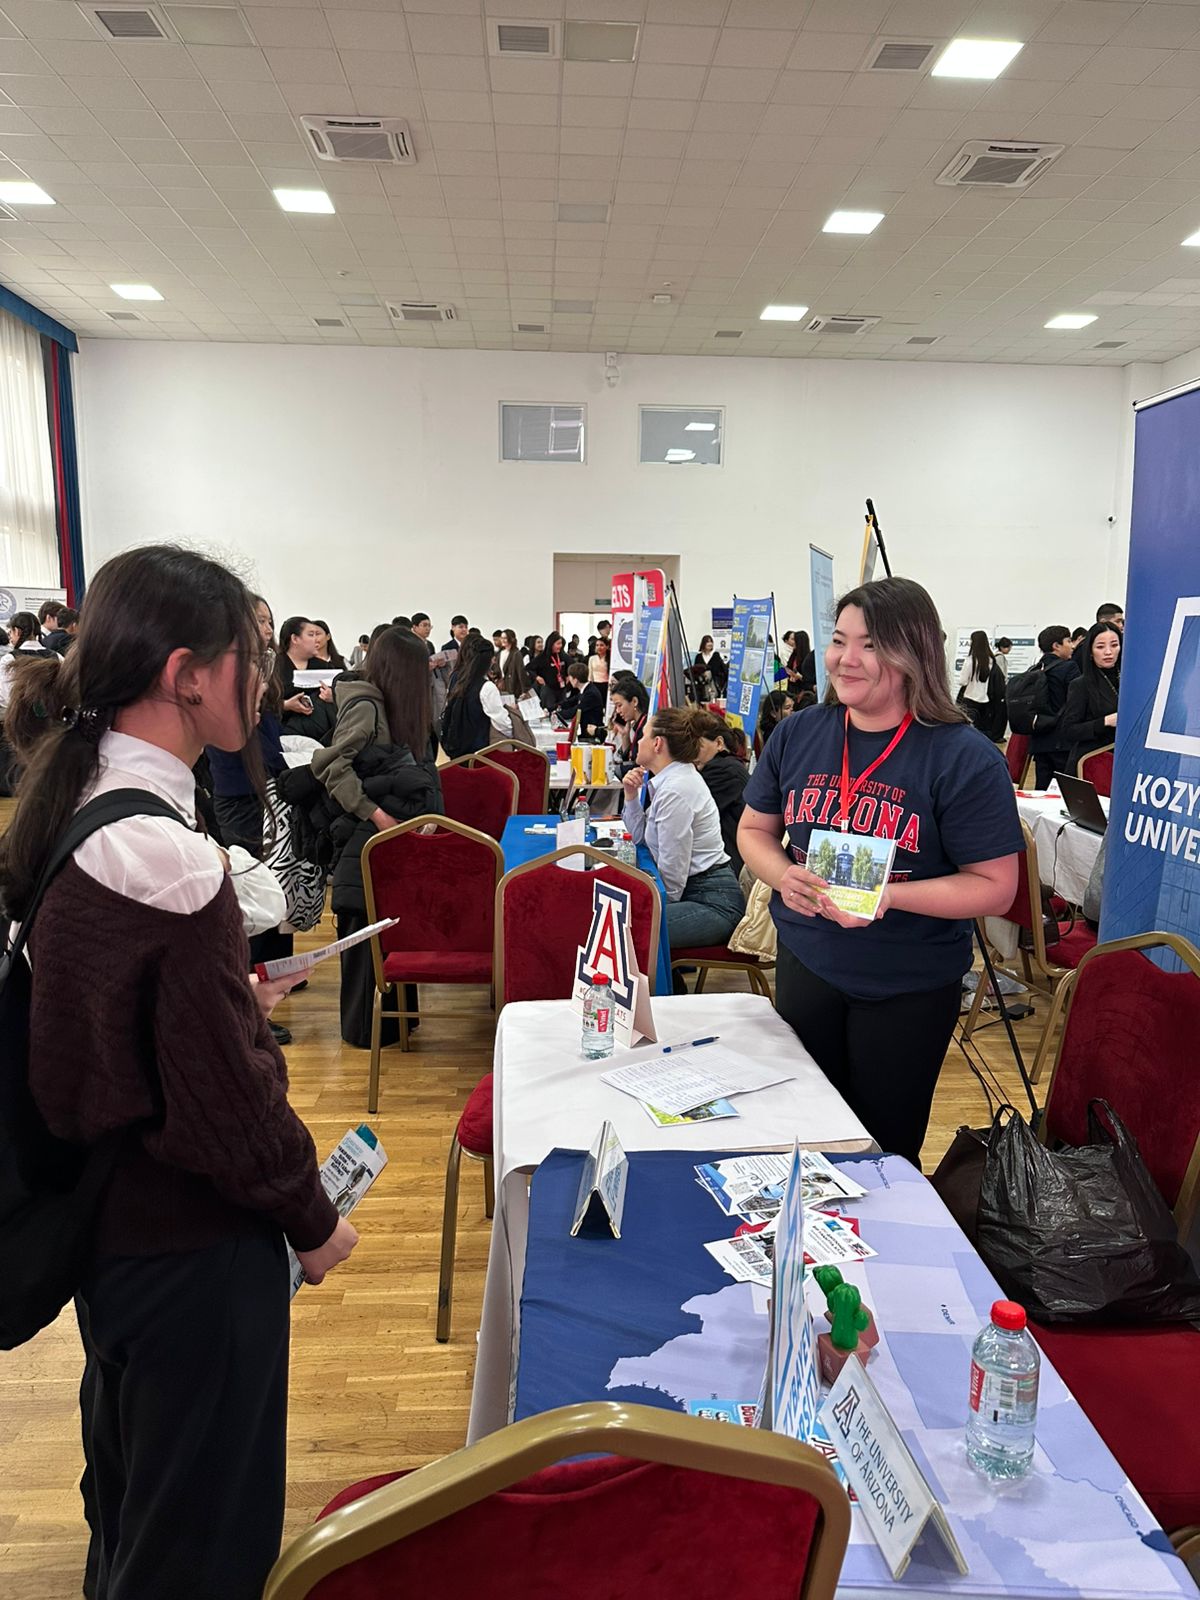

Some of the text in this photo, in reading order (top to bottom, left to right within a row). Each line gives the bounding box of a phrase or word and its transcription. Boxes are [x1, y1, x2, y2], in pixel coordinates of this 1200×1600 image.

[806, 773, 829, 786] THE
[890, 787, 906, 804] OF
[1131, 772, 1200, 819] KOZY
[1124, 811, 1200, 864] UNIVE
[851, 1441, 896, 1533] OF ARIZONA
[855, 1411, 914, 1524] THE UNIVERSITY
[1115, 1495, 1139, 1528] CHICAGO
